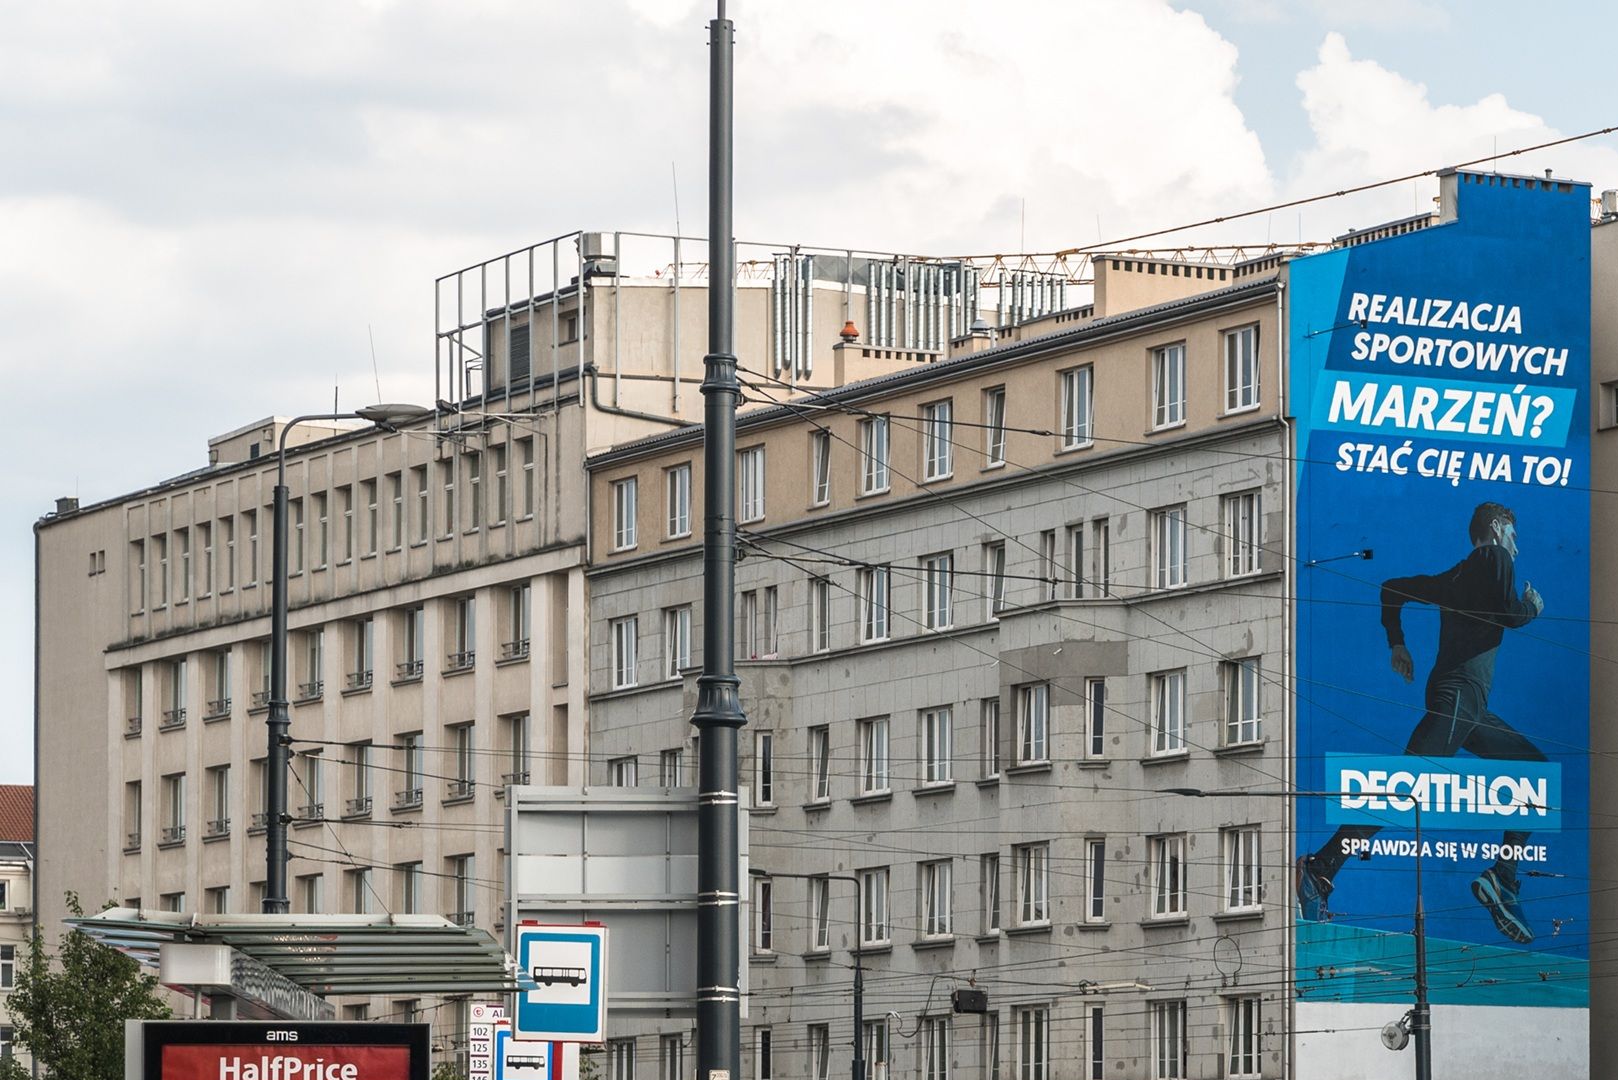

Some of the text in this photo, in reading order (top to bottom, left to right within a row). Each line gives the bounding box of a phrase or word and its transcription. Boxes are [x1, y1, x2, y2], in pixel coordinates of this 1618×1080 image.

[1348, 292, 1522, 334] REALIZACJA
[1351, 332, 1569, 377] SPORTOWYCH
[1327, 380, 1555, 439] MARZEŃ?
[1336, 440, 1572, 487] STAĆ CIĘ NA TO!
[1340, 769, 1547, 817] DECATHLON
[1435, 841, 1457, 862] SIĘ
[1460, 842, 1478, 859] W
[1481, 843, 1547, 862] SPORCIE
[265, 1030, 298, 1041] ams
[472, 1027, 488, 1036] 102
[472, 1043, 488, 1052] 125
[472, 1060, 488, 1069] 135
